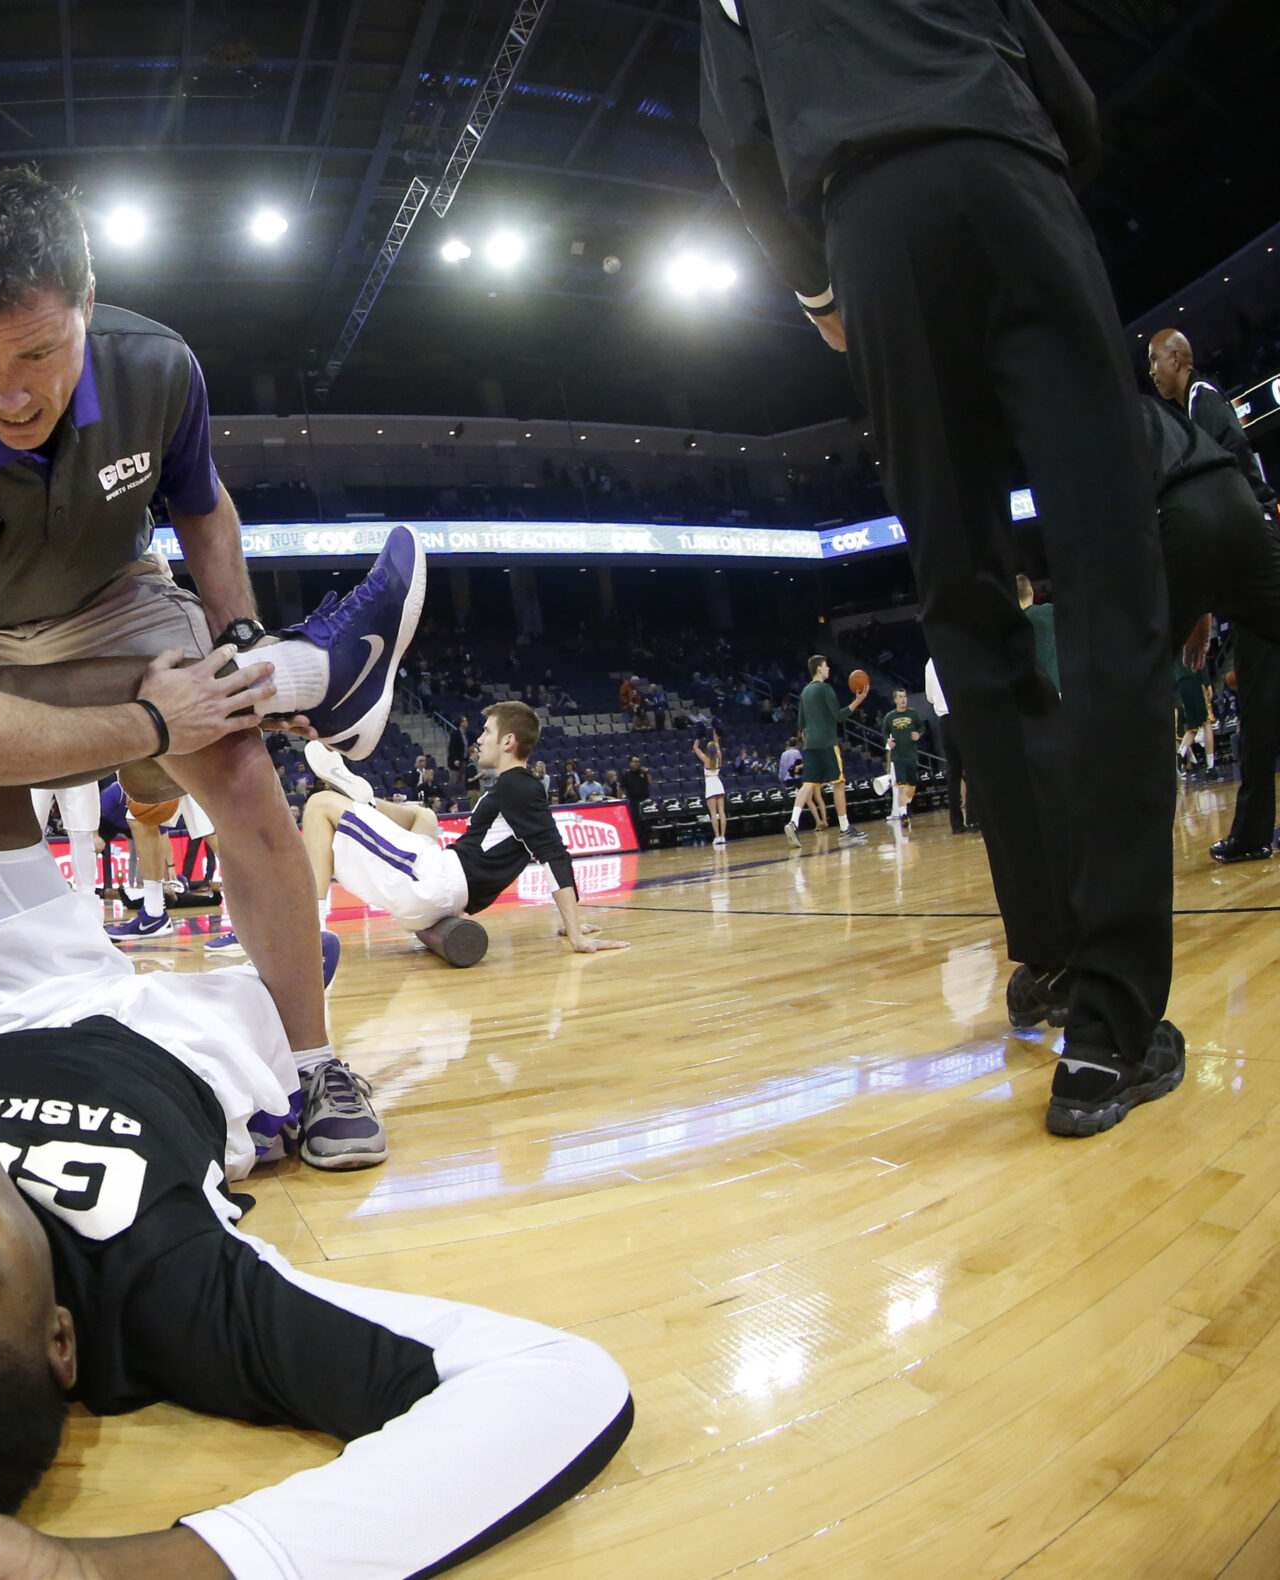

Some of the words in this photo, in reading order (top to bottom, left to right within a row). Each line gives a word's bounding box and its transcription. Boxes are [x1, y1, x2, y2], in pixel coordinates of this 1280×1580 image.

[98, 452, 150, 491] GCU
[304, 530, 362, 555] COX
[449, 533, 477, 548] ON
[479, 533, 517, 548] THE
[521, 533, 586, 548] ACTION
[611, 532, 653, 550] COX
[678, 534, 719, 549] TURN
[721, 535, 741, 550] ON
[742, 536, 770, 551] THE
[772, 537, 820, 554] ACTION
[832, 527, 869, 551] COX
